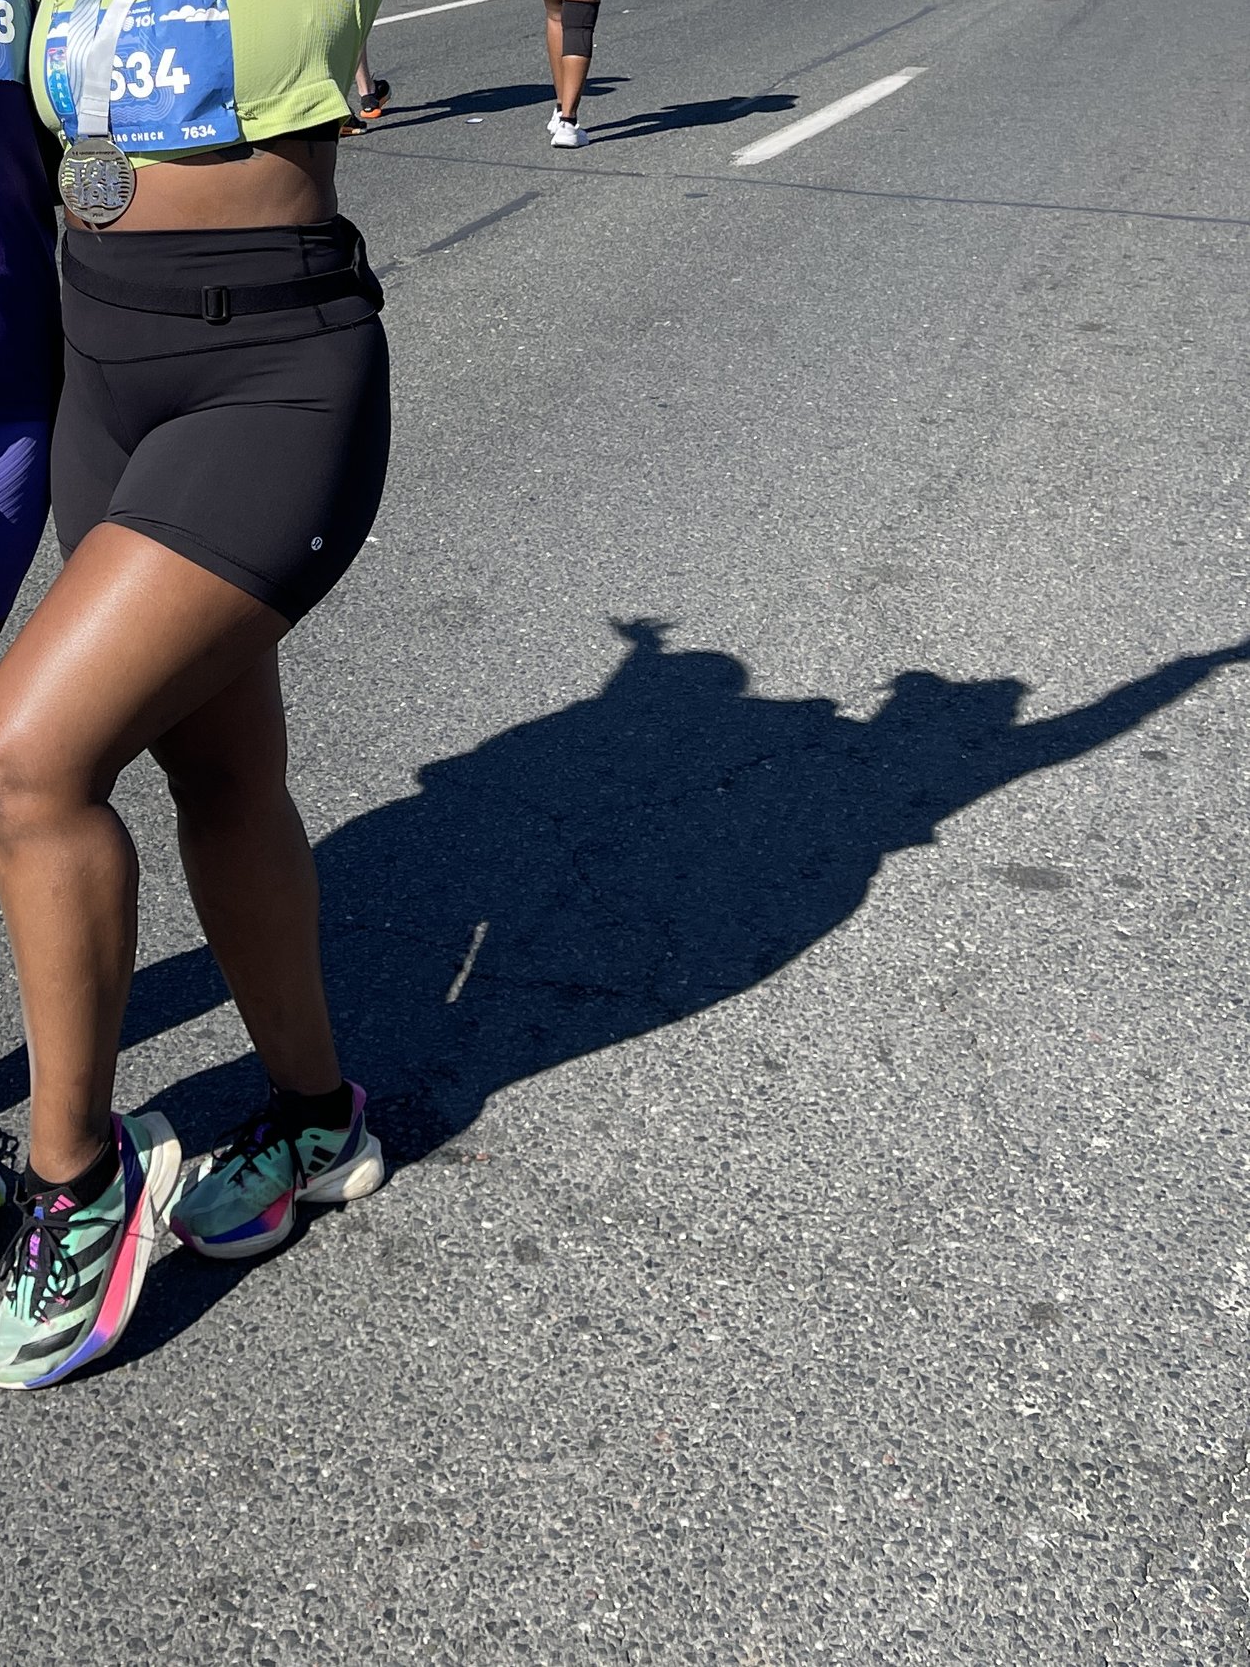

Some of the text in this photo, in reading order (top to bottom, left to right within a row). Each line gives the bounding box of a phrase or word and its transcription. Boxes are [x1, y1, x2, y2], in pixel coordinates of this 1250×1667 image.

[110, 48, 191, 102] 634
[112, 131, 165, 143] AG CHECK
[181, 124, 217, 140] 7634
